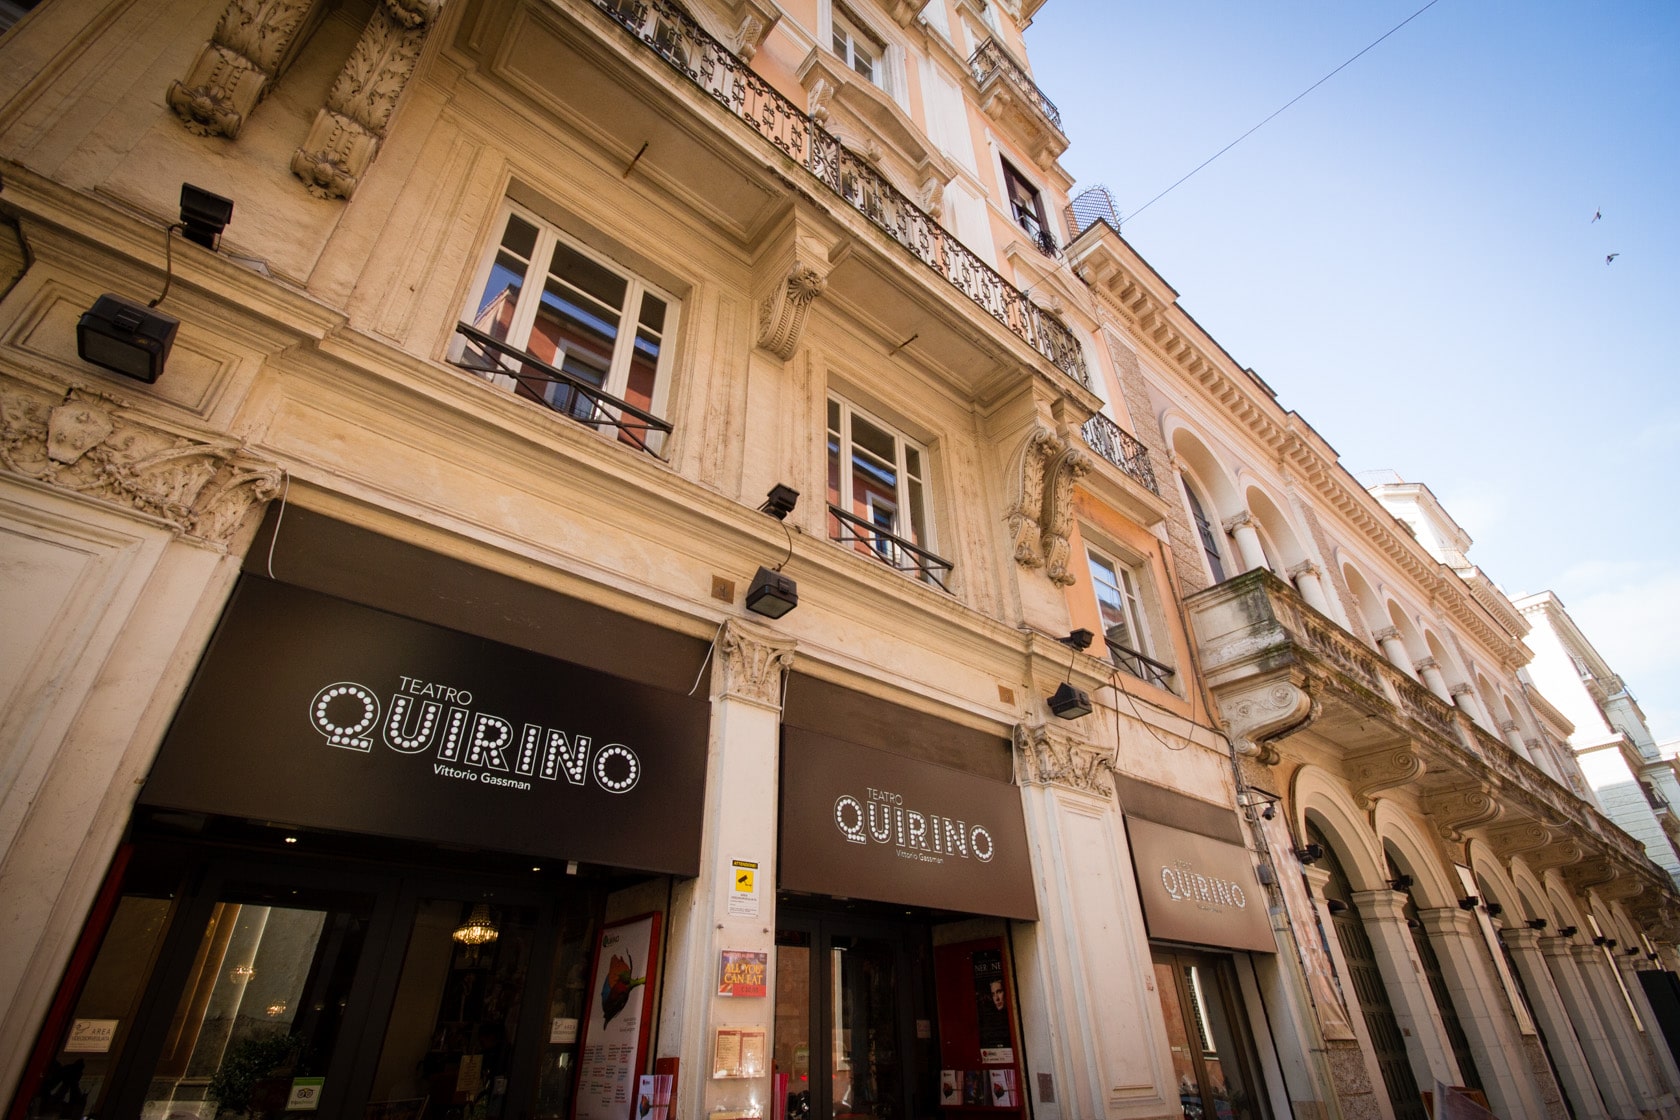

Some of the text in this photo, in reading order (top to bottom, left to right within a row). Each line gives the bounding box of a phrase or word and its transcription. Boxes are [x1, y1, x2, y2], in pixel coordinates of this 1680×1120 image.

[400, 676, 473, 706] TEATRO
[309, 682, 641, 794] QUIRINO
[433, 764, 532, 791] Vittorio Gassman
[867, 787, 903, 806] TEATRO
[834, 795, 995, 863] QUIRINO
[895, 849, 944, 864] Vittorio Gassman
[1161, 866, 1246, 911] QUIRINO
[724, 973, 763, 985] CAN EAT
[725, 963, 741, 973] ALL
